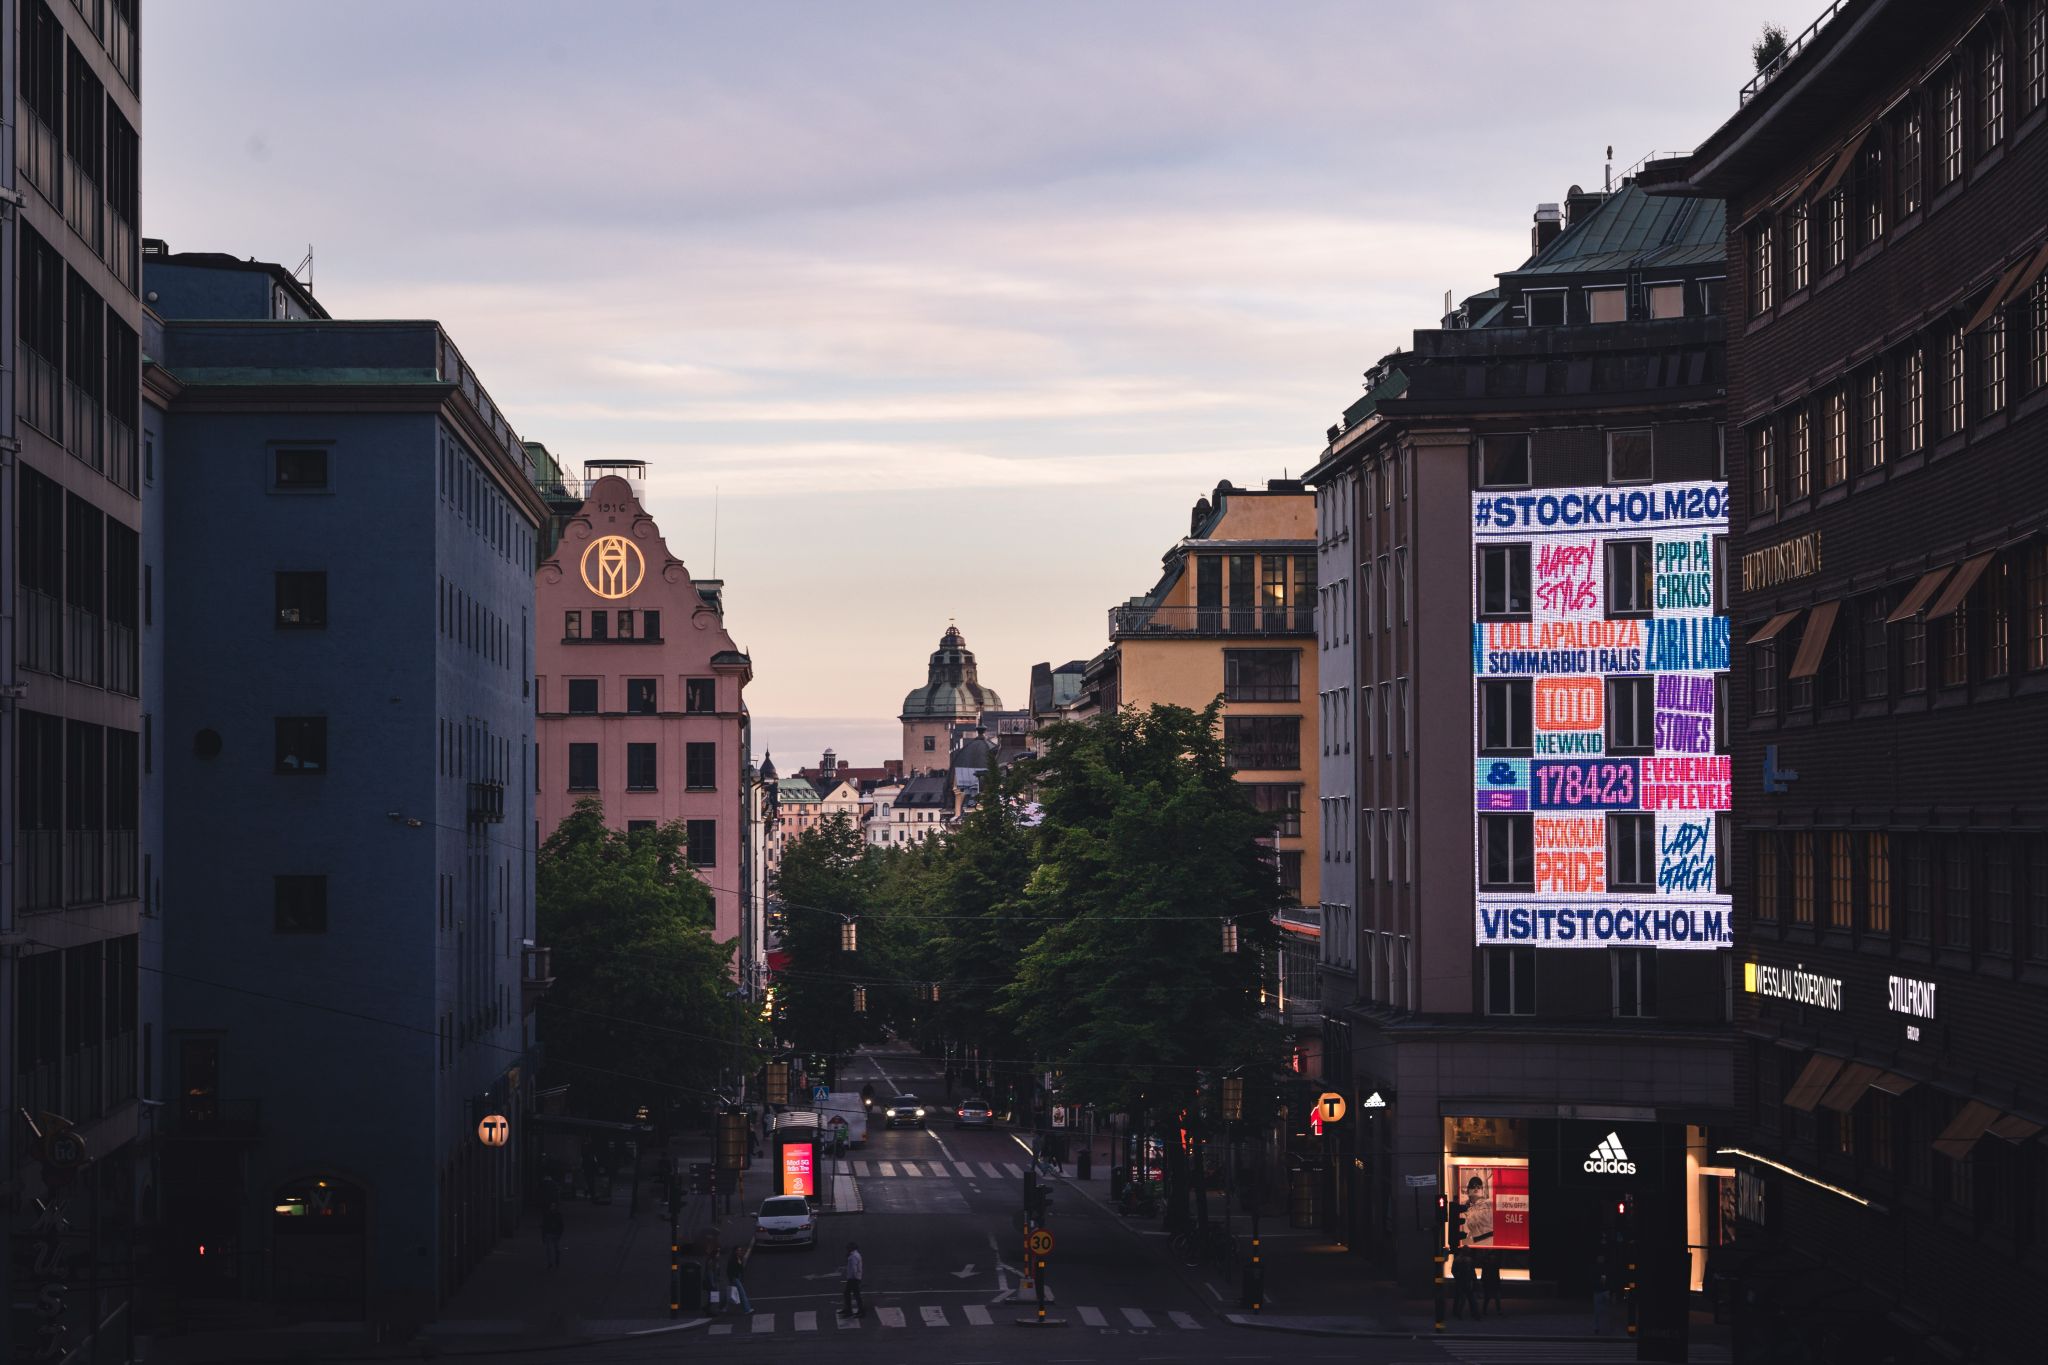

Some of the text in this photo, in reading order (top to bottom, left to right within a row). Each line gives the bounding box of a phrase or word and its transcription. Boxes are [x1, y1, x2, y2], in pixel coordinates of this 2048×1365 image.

[598, 503, 626, 513] 1916
[1656, 533, 1710, 574] PIPPI PÅ
[1656, 573, 1711, 609] CIRKUS
[1489, 618, 1641, 650] LOLLAPALOOZA
[1644, 618, 1687, 671] ZARA
[1488, 650, 1588, 674] SOMMARBIO
[1590, 649, 1596, 672] I
[1541, 688, 1596, 721] TOTO
[1656, 675, 1713, 715] ROLLING
[1536, 733, 1602, 755] NEWKID
[1655, 712, 1712, 754] STONES
[1486, 762, 1516, 786] &
[1536, 764, 1634, 805] 178423
[1535, 818, 1604, 849] STOCKHOLM
[1661, 817, 1711, 863] LADY
[1535, 852, 1605, 893] PRIDE
[1658, 854, 1715, 895] GAGA
[1480, 908, 1733, 942] VISITSTOCKHOLM.
[1756, 963, 1842, 1012] WESSLAU SÖDERQVIST
[1888, 975, 1937, 1020] STILLFRONT
[1323, 1097, 1341, 1118] T
[483, 1122, 497, 1142] T
[1583, 1157, 1637, 1175] adidas
[1505, 1213, 1524, 1223] SALE
[1032, 1235, 1051, 1250] 30
